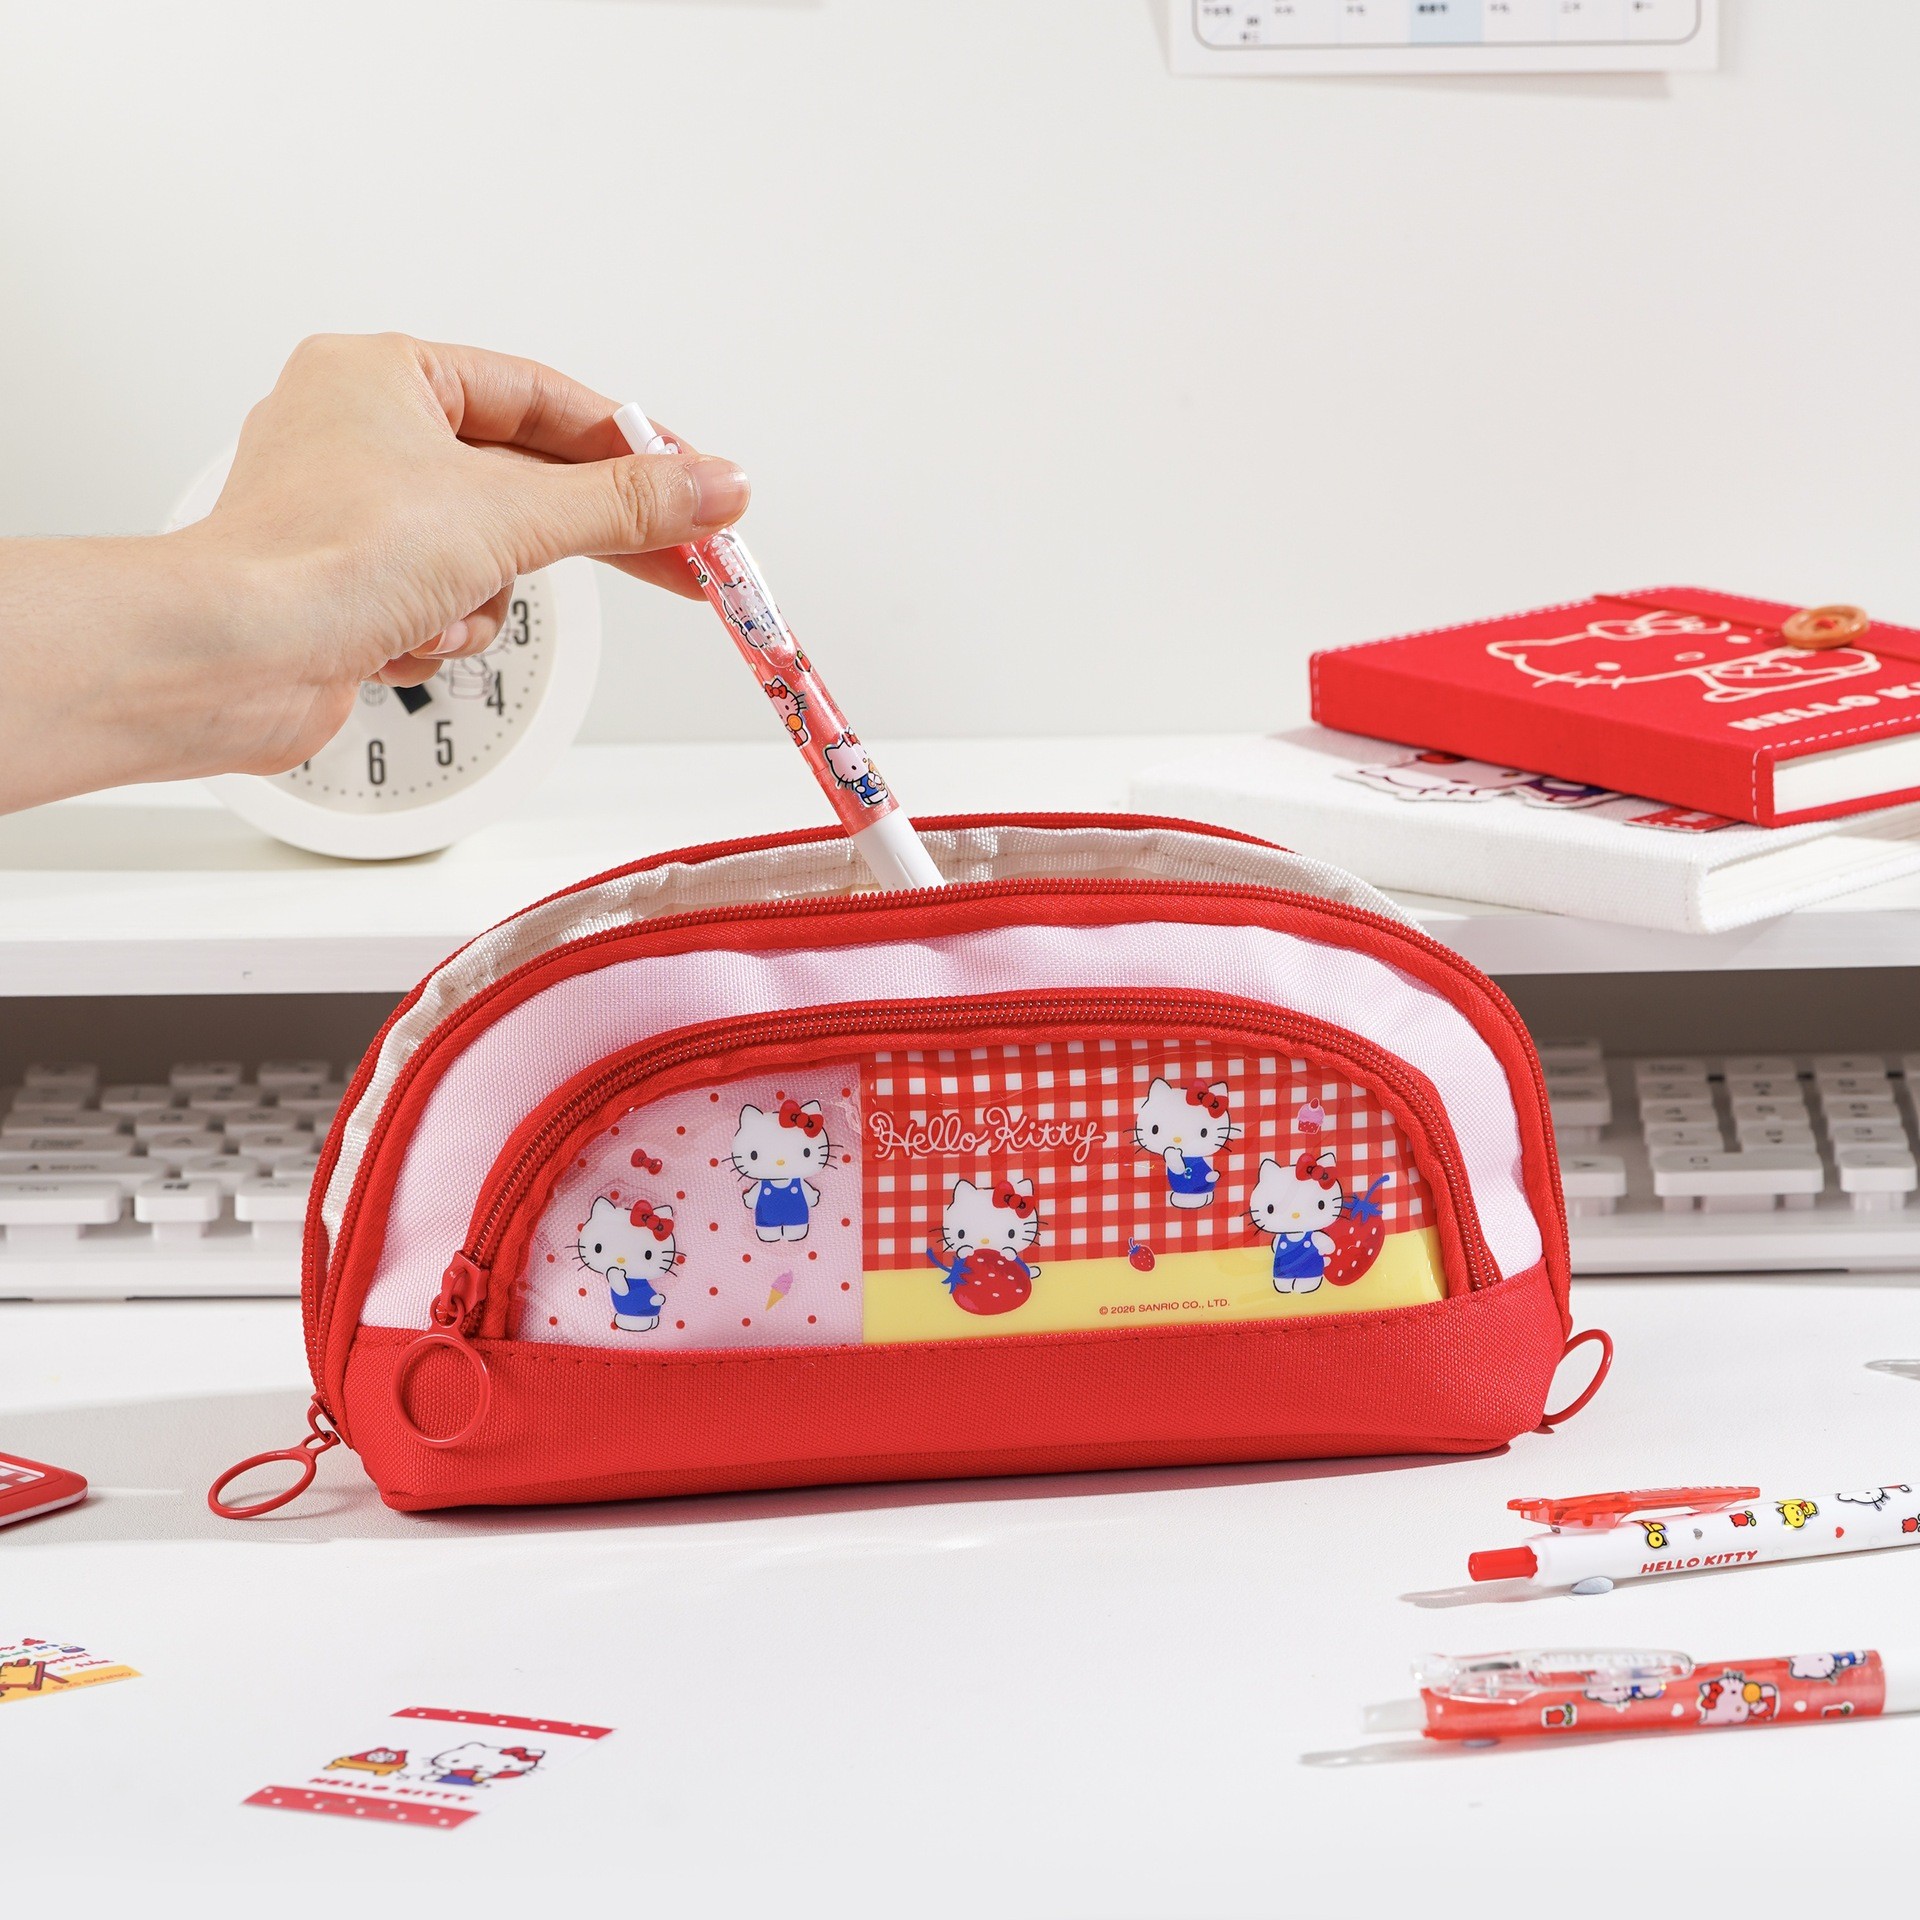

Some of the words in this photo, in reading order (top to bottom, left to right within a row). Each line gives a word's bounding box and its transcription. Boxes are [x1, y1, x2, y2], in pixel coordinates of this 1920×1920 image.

[512, 599, 529, 646] 3
[485, 669, 505, 716] 4
[1727, 694, 1881, 731] HELLO
[368, 740, 386, 785] 6
[435, 720, 453, 766] 5
[868, 1110, 989, 1158] Hello
[986, 1106, 1104, 1163] Kitty
[1111, 1305, 1135, 1314] 2026
[1138, 1301, 1179, 1313] SANRIO
[1182, 1300, 1204, 1309] CO.,
[1207, 1298, 1230, 1308] LTD.
[1640, 1557, 1700, 1574] HELLO
[1703, 1549, 1759, 1567] KITTY
